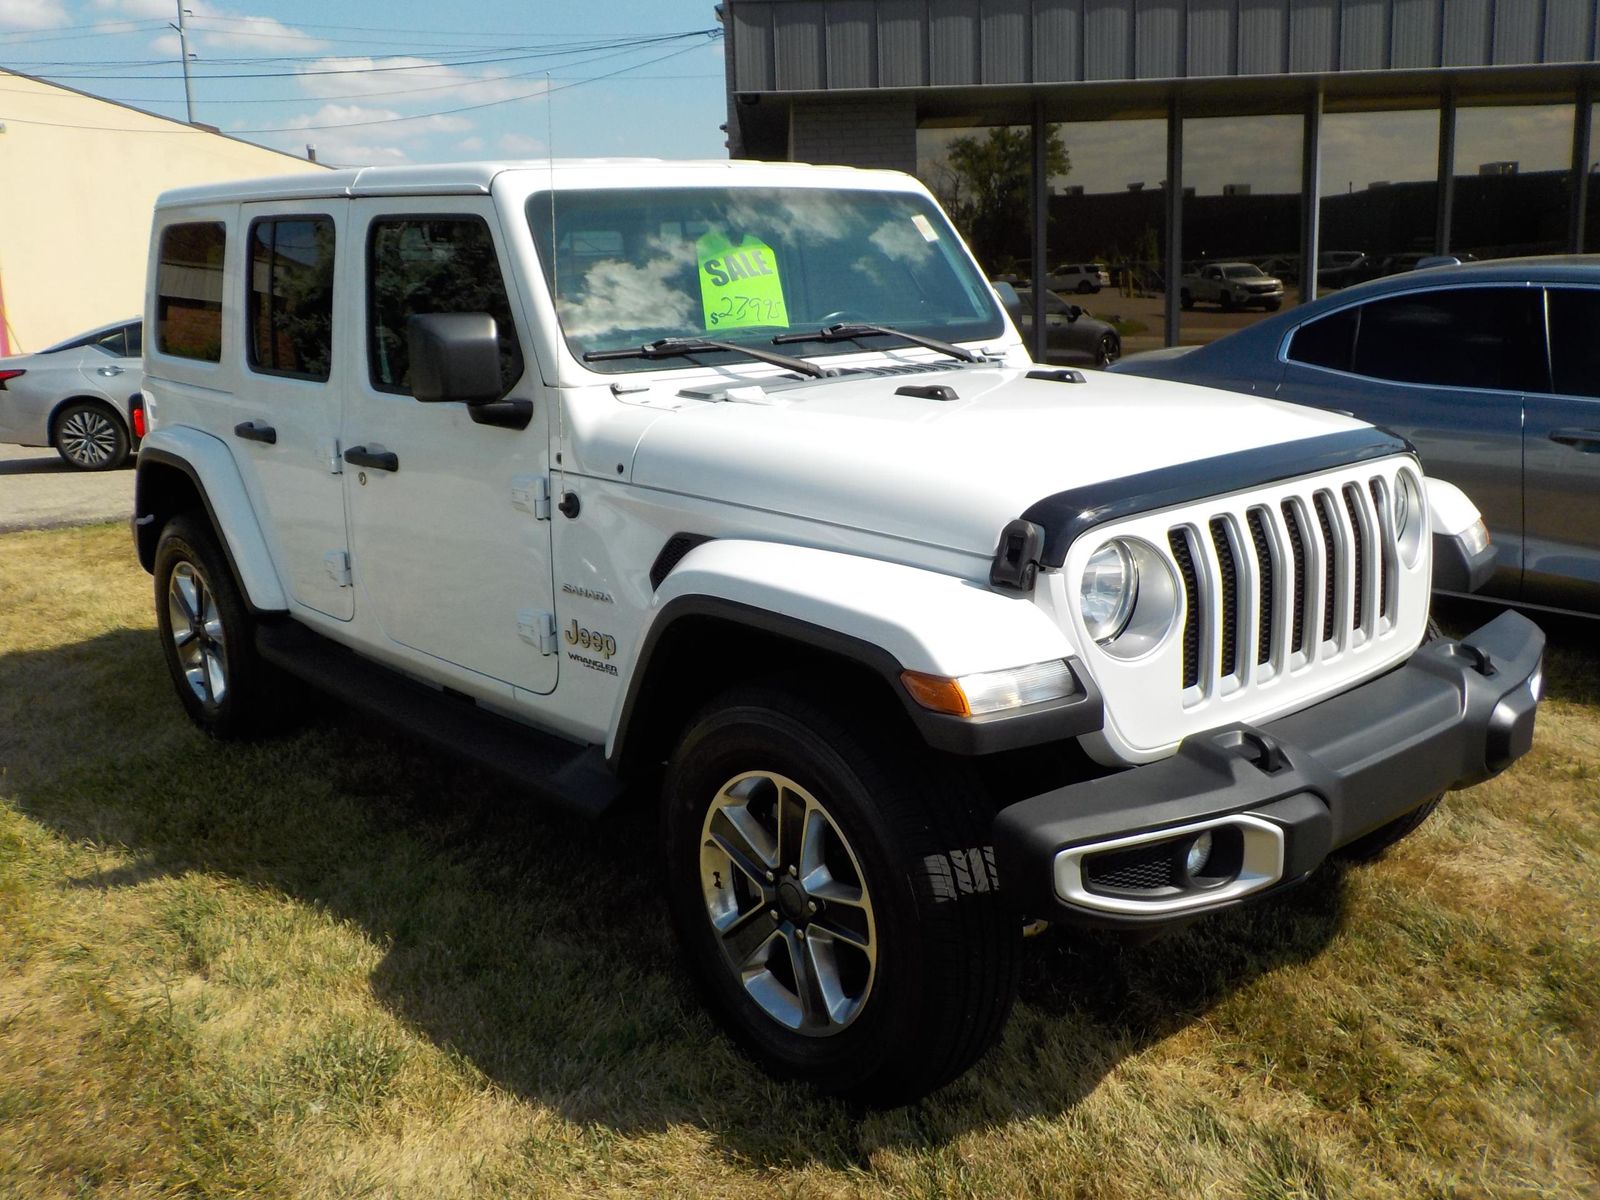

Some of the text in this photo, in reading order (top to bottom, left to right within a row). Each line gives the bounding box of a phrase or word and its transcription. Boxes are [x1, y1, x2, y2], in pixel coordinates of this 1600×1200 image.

[704, 250, 773, 287] SALE
[562, 583, 615, 603] SAHARA
[565, 619, 617, 660] Jeep
[568, 651, 618, 672] WRANGLER
